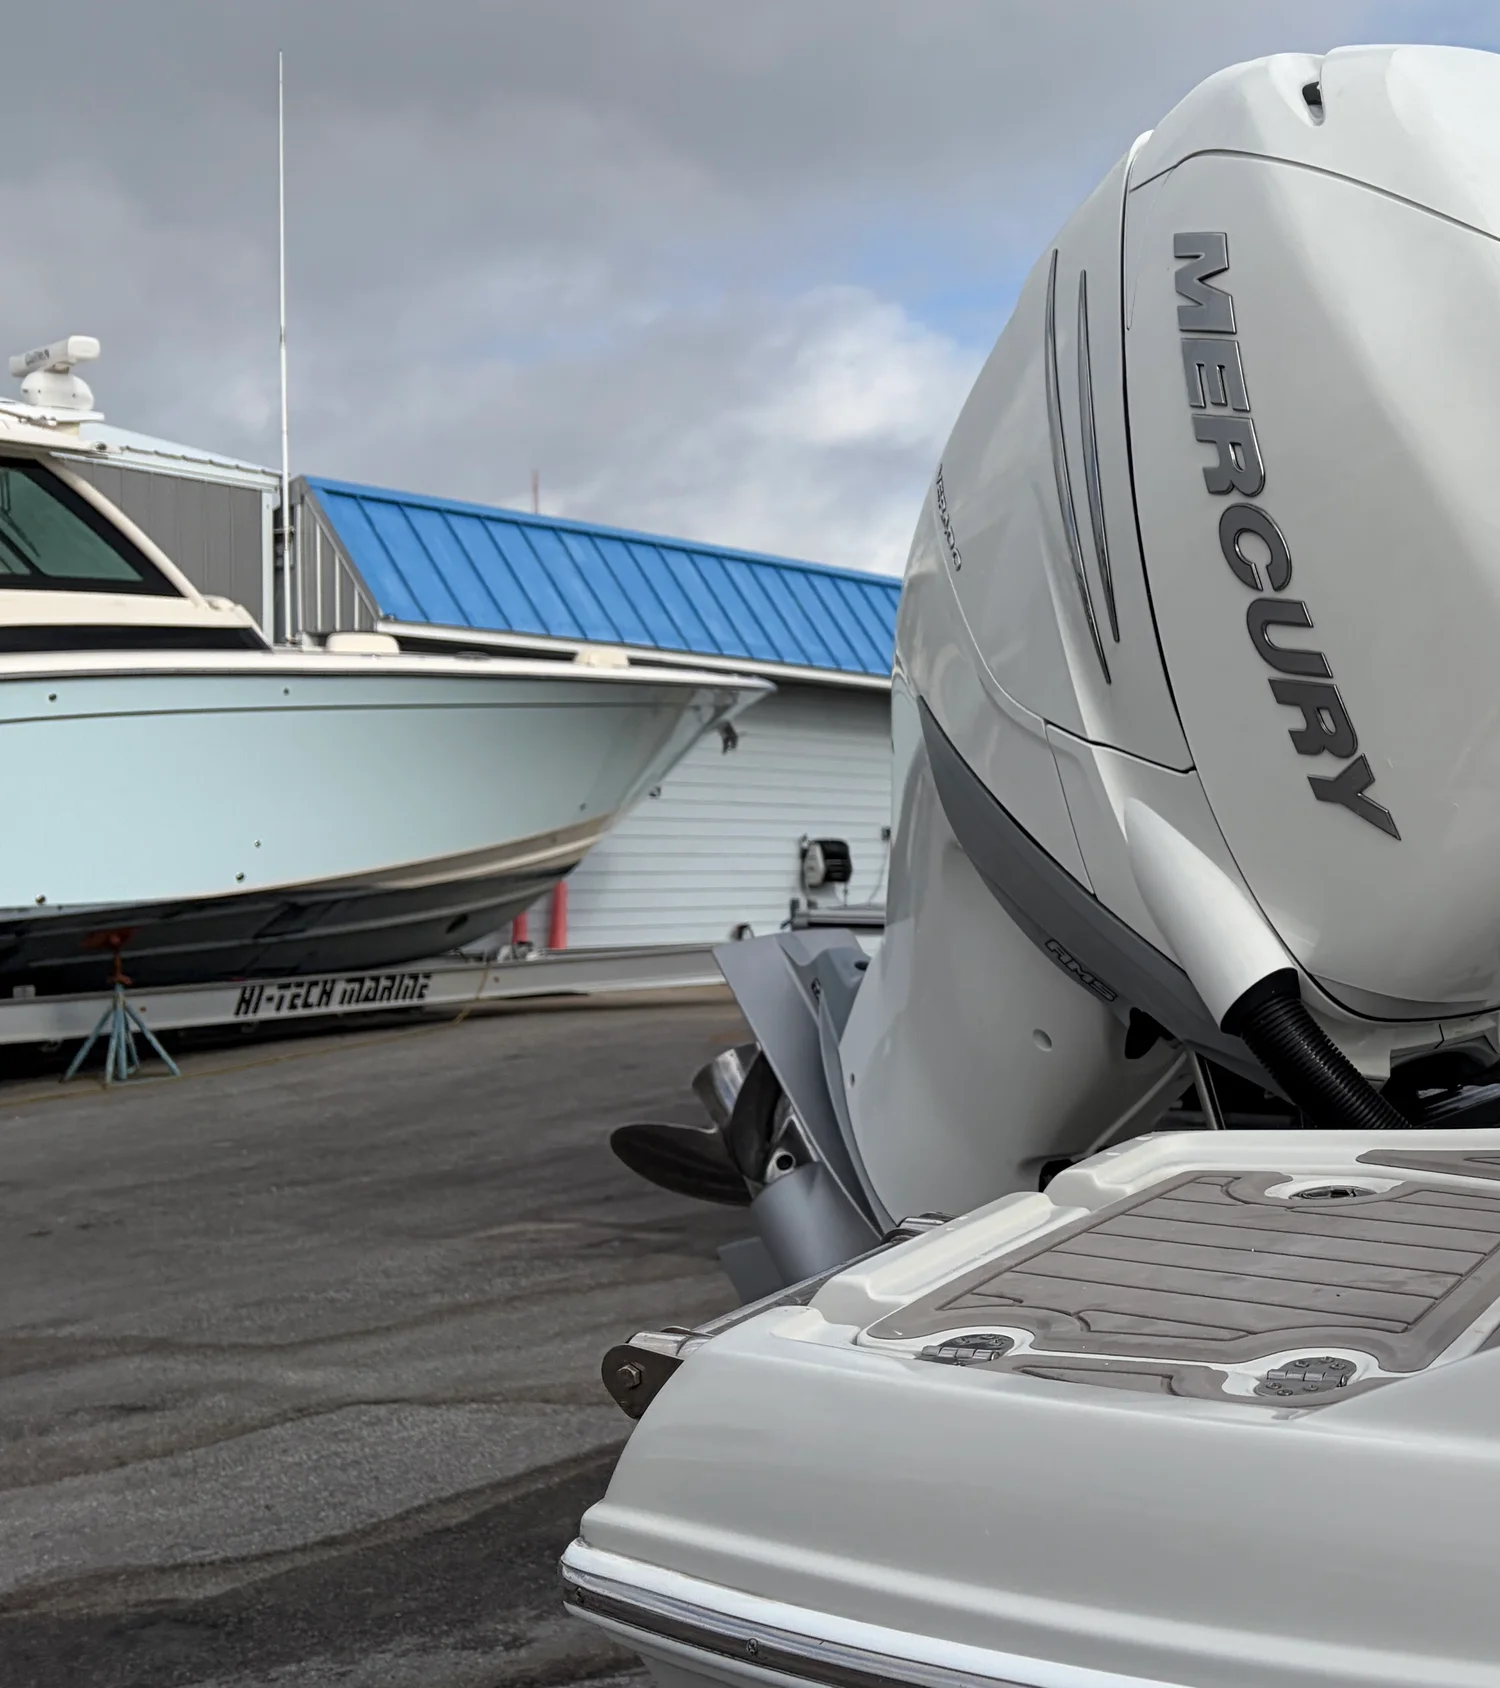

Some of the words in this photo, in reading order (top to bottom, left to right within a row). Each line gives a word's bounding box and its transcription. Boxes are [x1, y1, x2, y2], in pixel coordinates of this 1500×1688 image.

[1172, 231, 1402, 841] MERCURY
[234, 979, 336, 1016] HI-TECH
[338, 972, 432, 1006] MARINE
